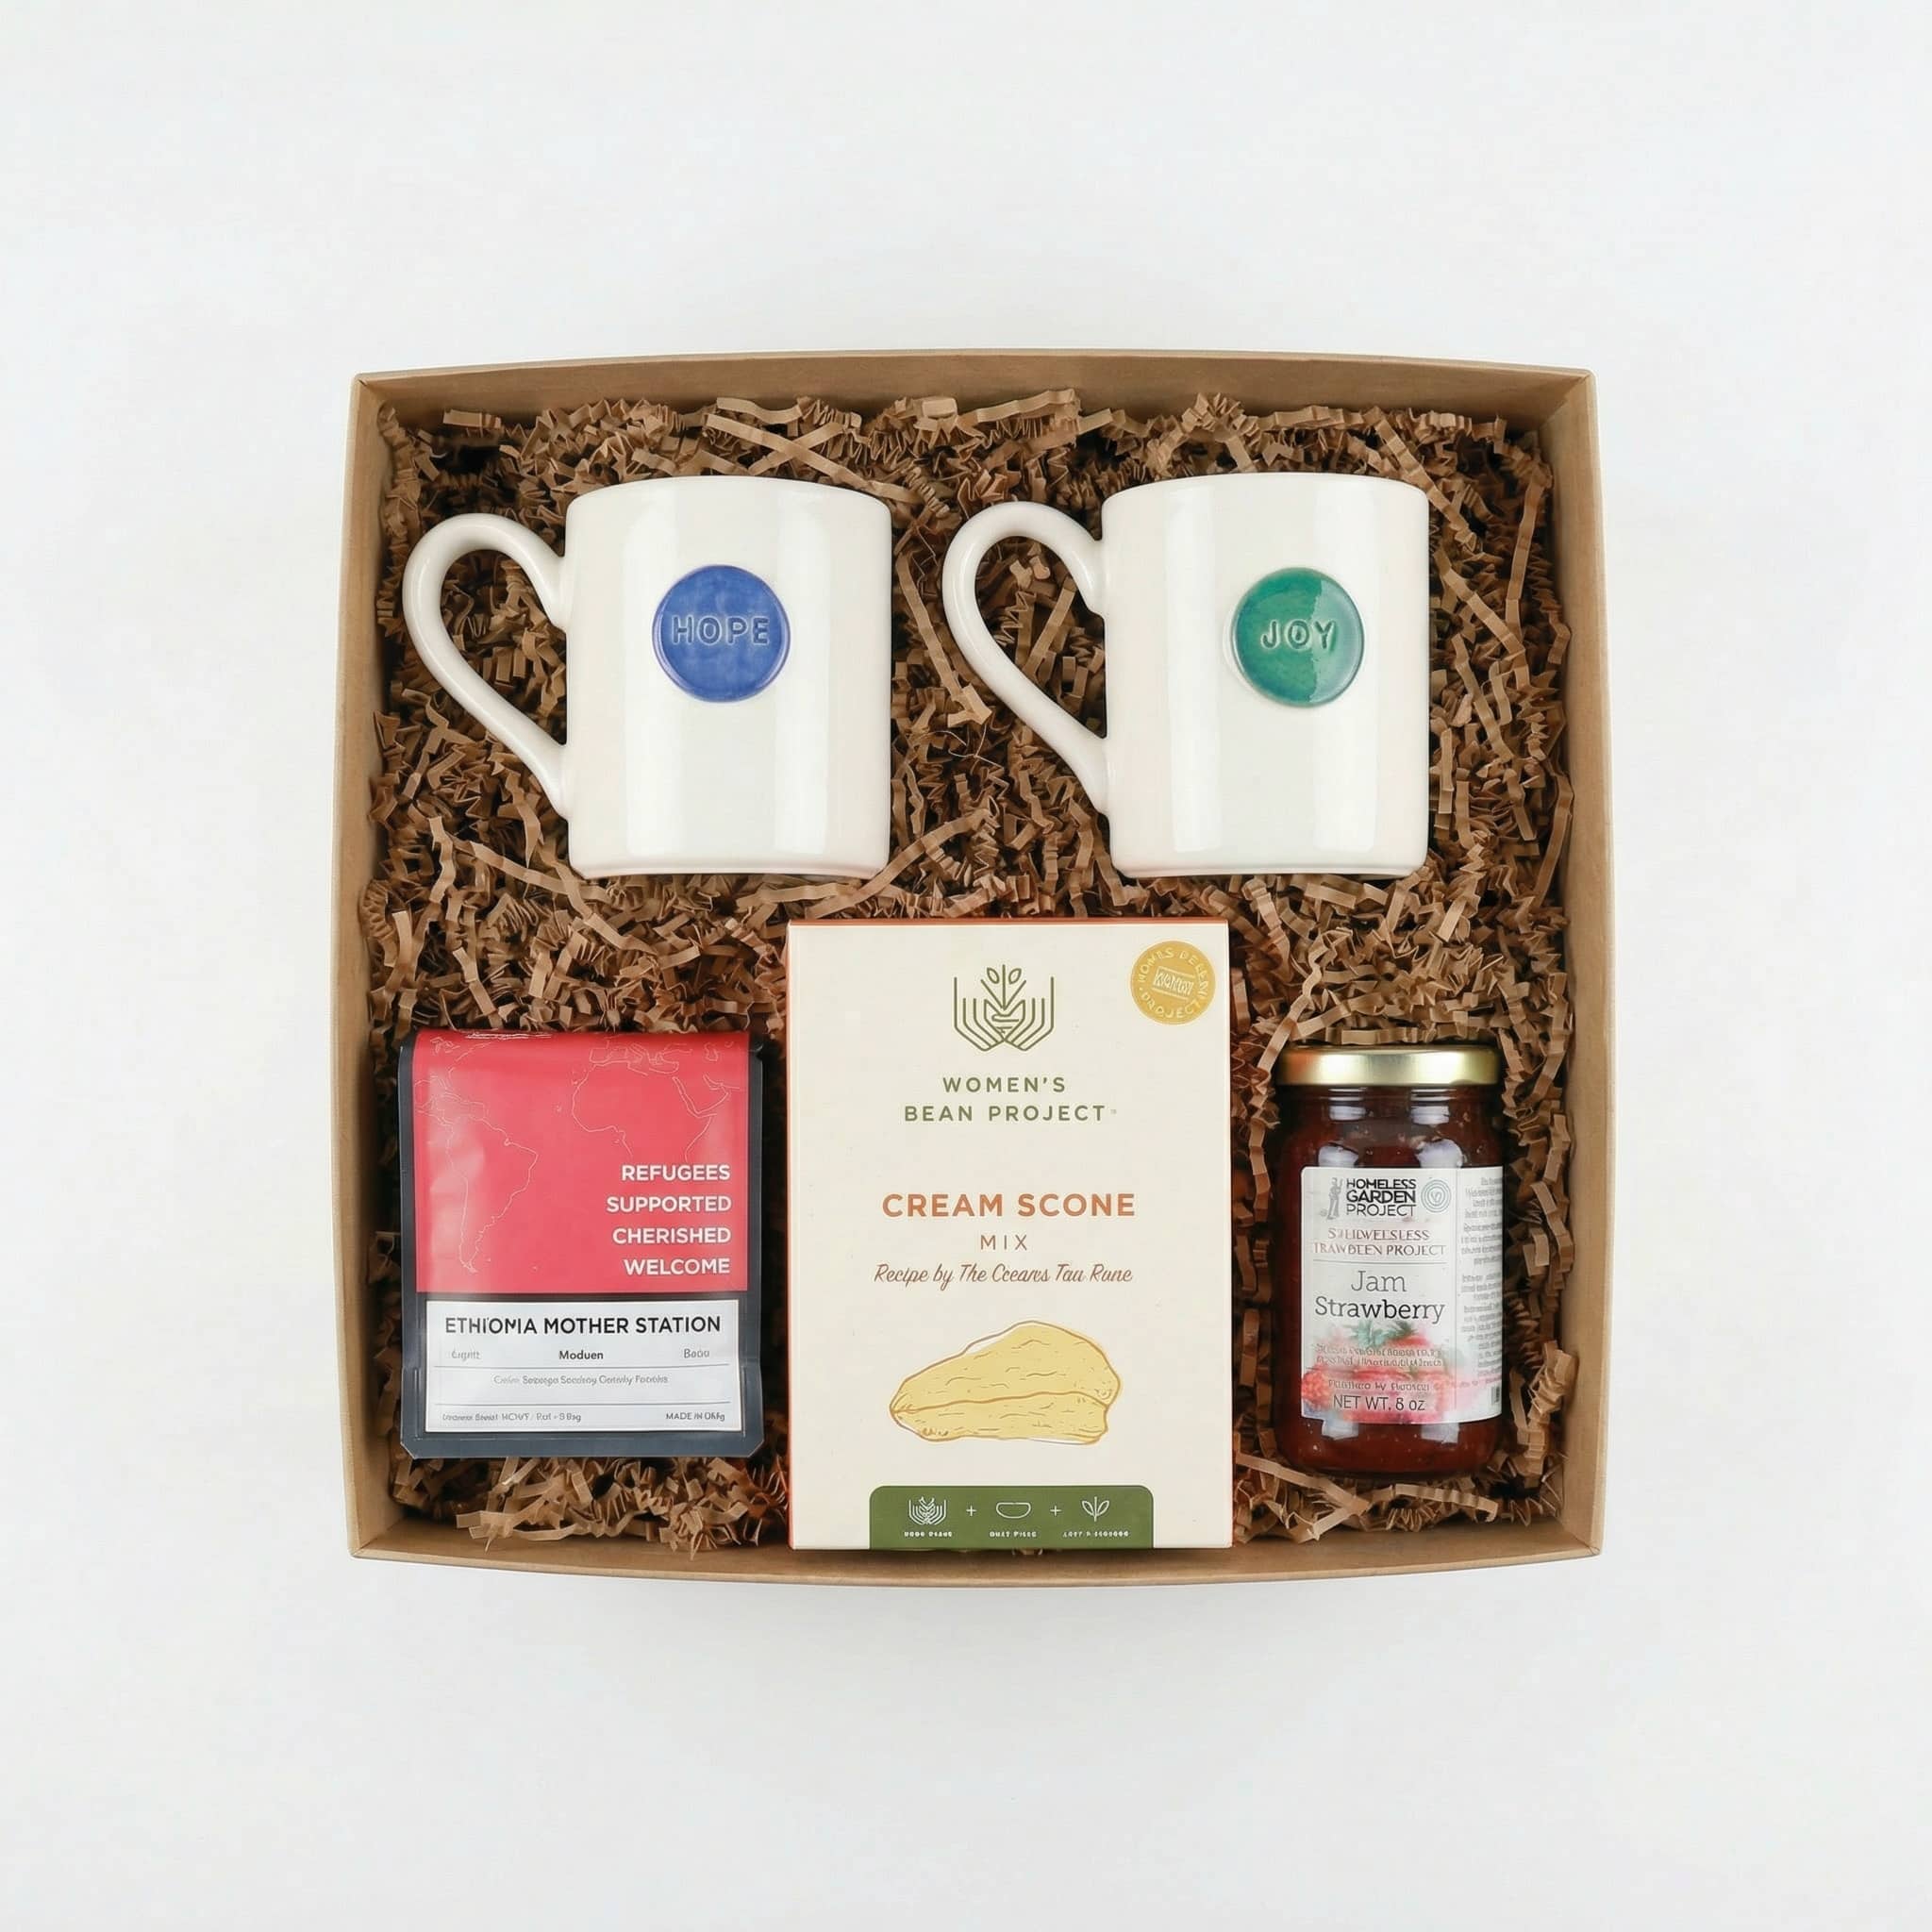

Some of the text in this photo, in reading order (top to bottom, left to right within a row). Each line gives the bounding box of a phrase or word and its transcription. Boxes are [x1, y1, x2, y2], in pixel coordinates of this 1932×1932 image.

[672, 614, 770, 646] HOPE
[1260, 619, 1336, 651] JOY
[942, 1076, 1066, 1092] WOMEN'S
[904, 1105, 1106, 1122] BEAN PROJECT
[621, 1164, 731, 1182] REFUGEES
[1346, 1178, 1417, 1190] HOMELESS
[606, 1195, 732, 1213] SUPPORTED
[882, 1193, 1136, 1217] CREAM SCONE
[1346, 1190, 1416, 1204] GARDEN
[1346, 1204, 1416, 1217] PROJECT
[612, 1227, 732, 1245] CHERISHED
[980, 1234, 1028, 1251] MIX
[623, 1258, 731, 1275] WELCOME
[874, 1262, 930, 1288] Recipe
[933, 1263, 954, 1291] by
[959, 1263, 988, 1283] The
[1351, 1270, 1407, 1292] Jam
[1315, 1296, 1446, 1324] Strawberry
[543, 1317, 630, 1335] MOTHER
[635, 1315, 721, 1334] STATION
[1333, 1394, 1361, 1409] NET
[1365, 1395, 1391, 1410] WT.
